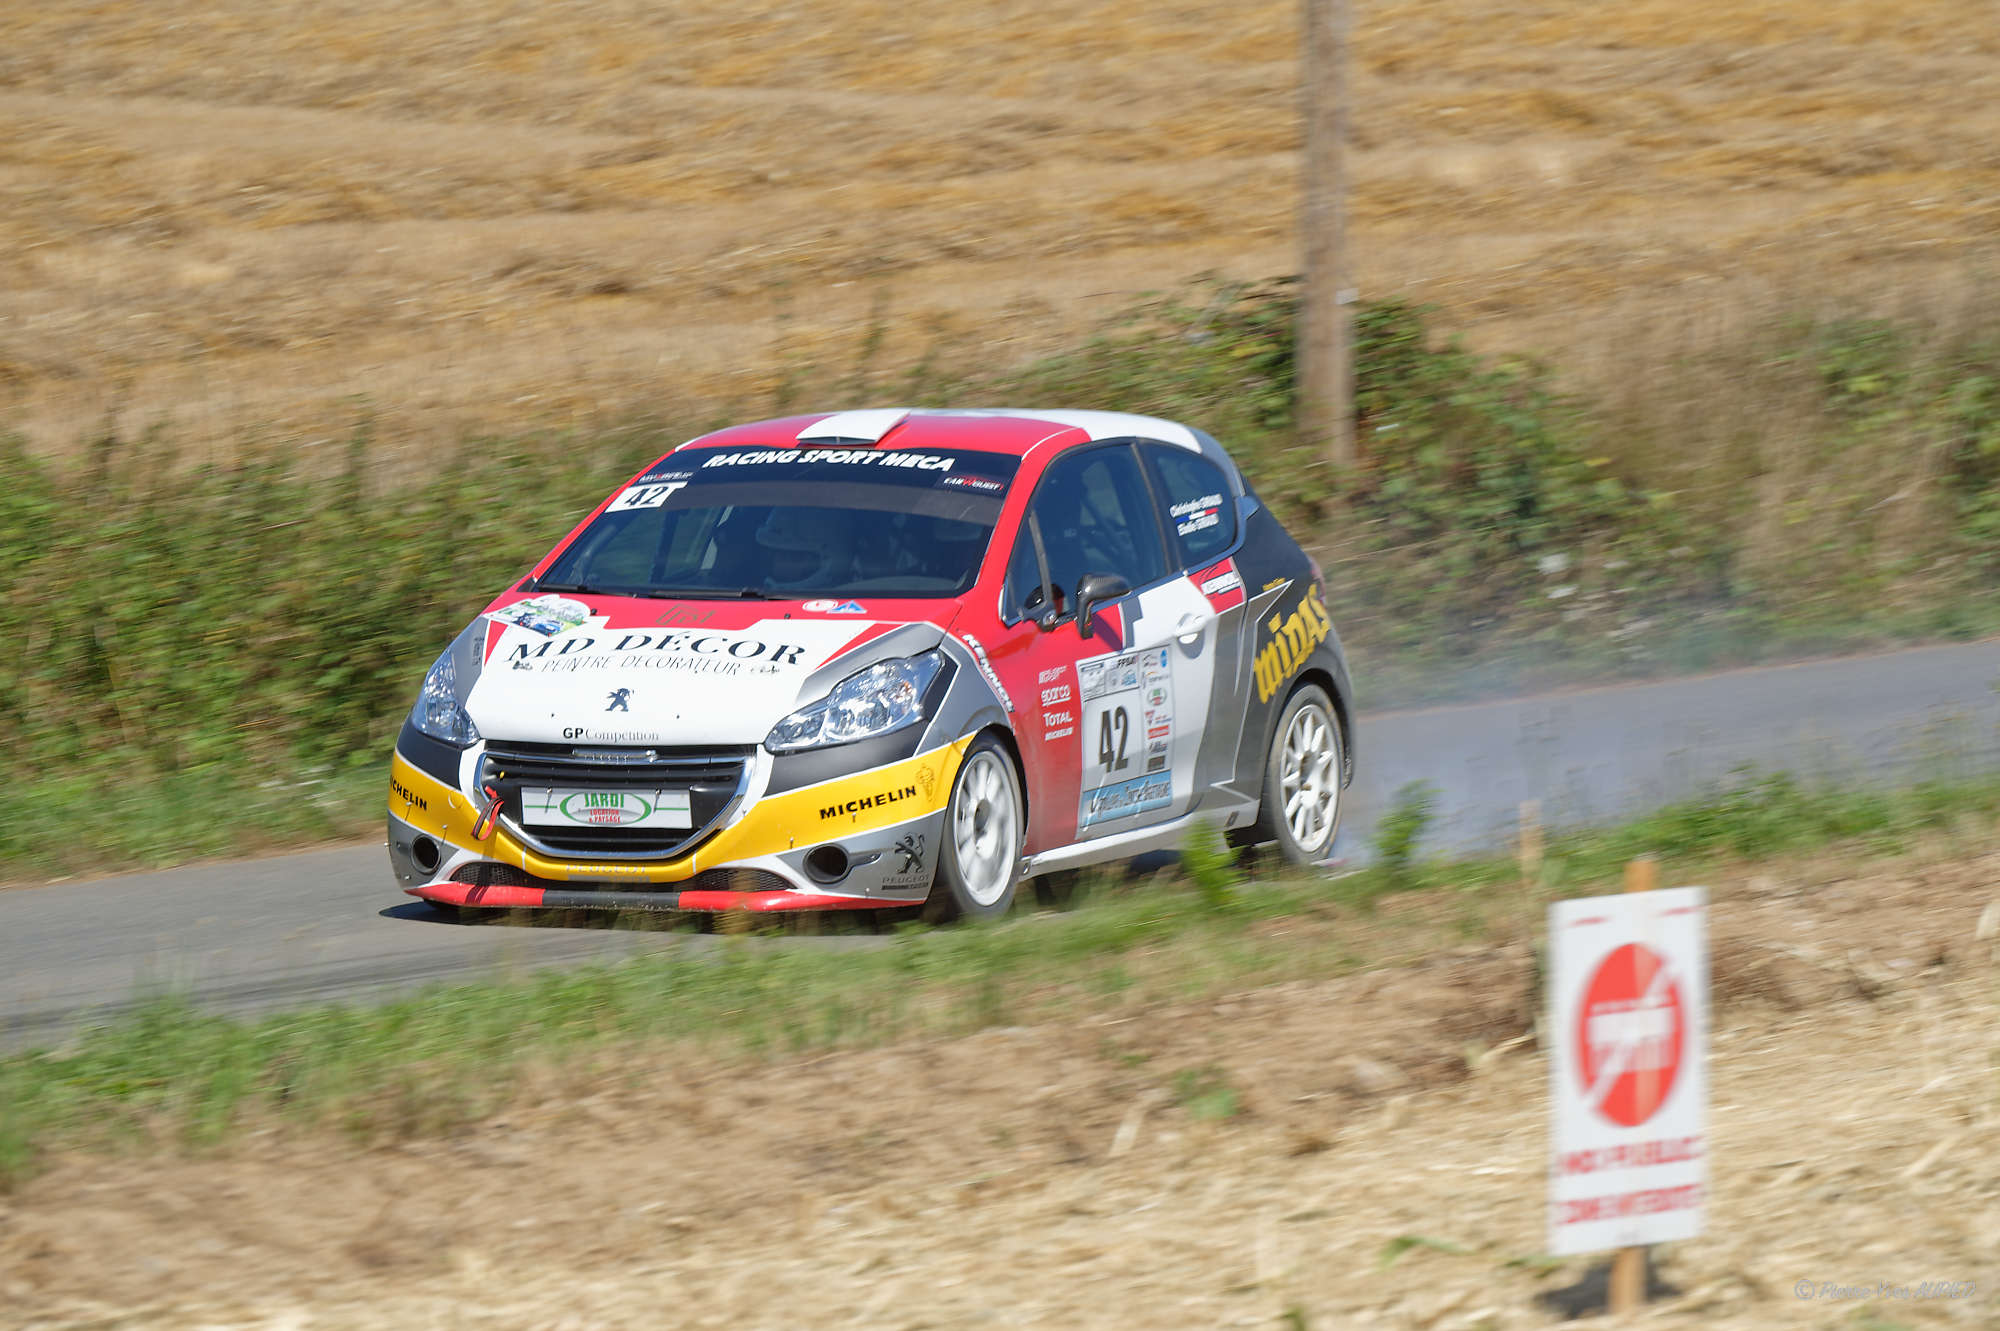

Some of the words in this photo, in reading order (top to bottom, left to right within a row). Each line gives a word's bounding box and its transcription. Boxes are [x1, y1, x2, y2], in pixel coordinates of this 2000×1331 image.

[702, 451, 799, 468] RACING
[797, 450, 884, 465] SPORT
[878, 453, 956, 472] MECA
[624, 486, 669, 506] 42
[504, 637, 596, 662] MD
[613, 631, 805, 665] DÉCOR
[542, 656, 612, 673] PEINTRE
[620, 655, 741, 676] DECORATEUR
[563, 728, 584, 739] GP
[585, 728, 660, 743] Competition
[1099, 705, 1129, 773] 42
[584, 793, 624, 809] JARDI
[819, 785, 917, 820] MICHELIN
[882, 875, 930, 884] PEUGEOT
